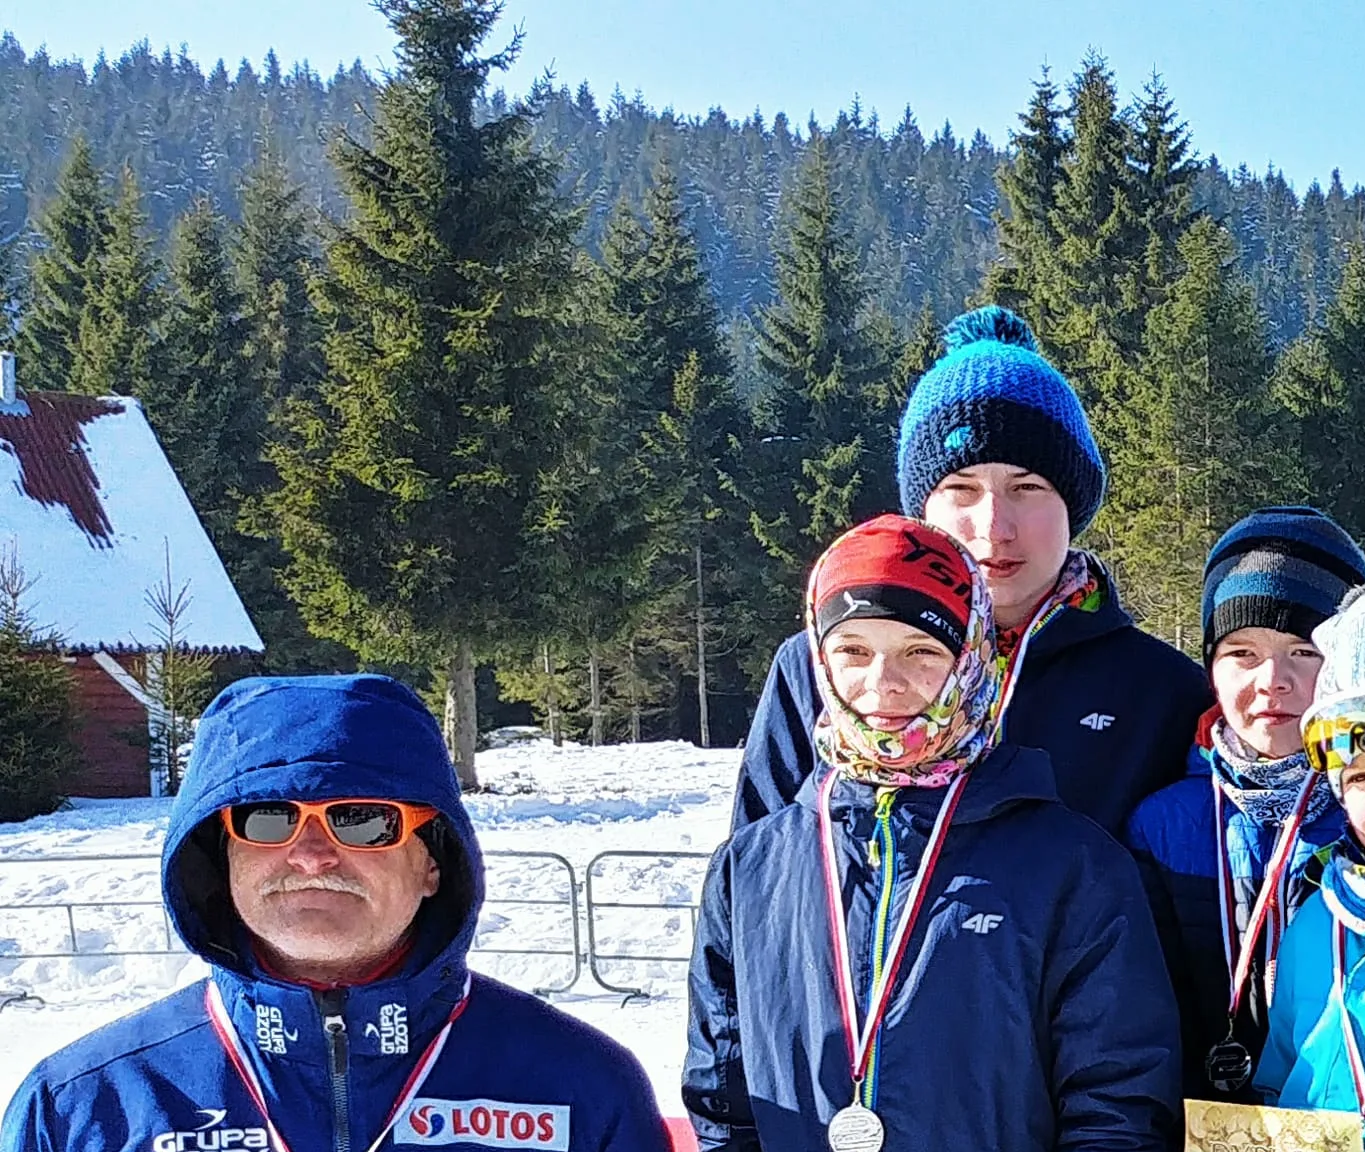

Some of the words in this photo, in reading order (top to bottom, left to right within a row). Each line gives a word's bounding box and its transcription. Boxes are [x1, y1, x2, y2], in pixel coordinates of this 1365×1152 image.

[1080, 713, 1116, 730] 4F
[962, 913, 1004, 934] 4F
[453, 1106, 555, 1142] LOTOS
